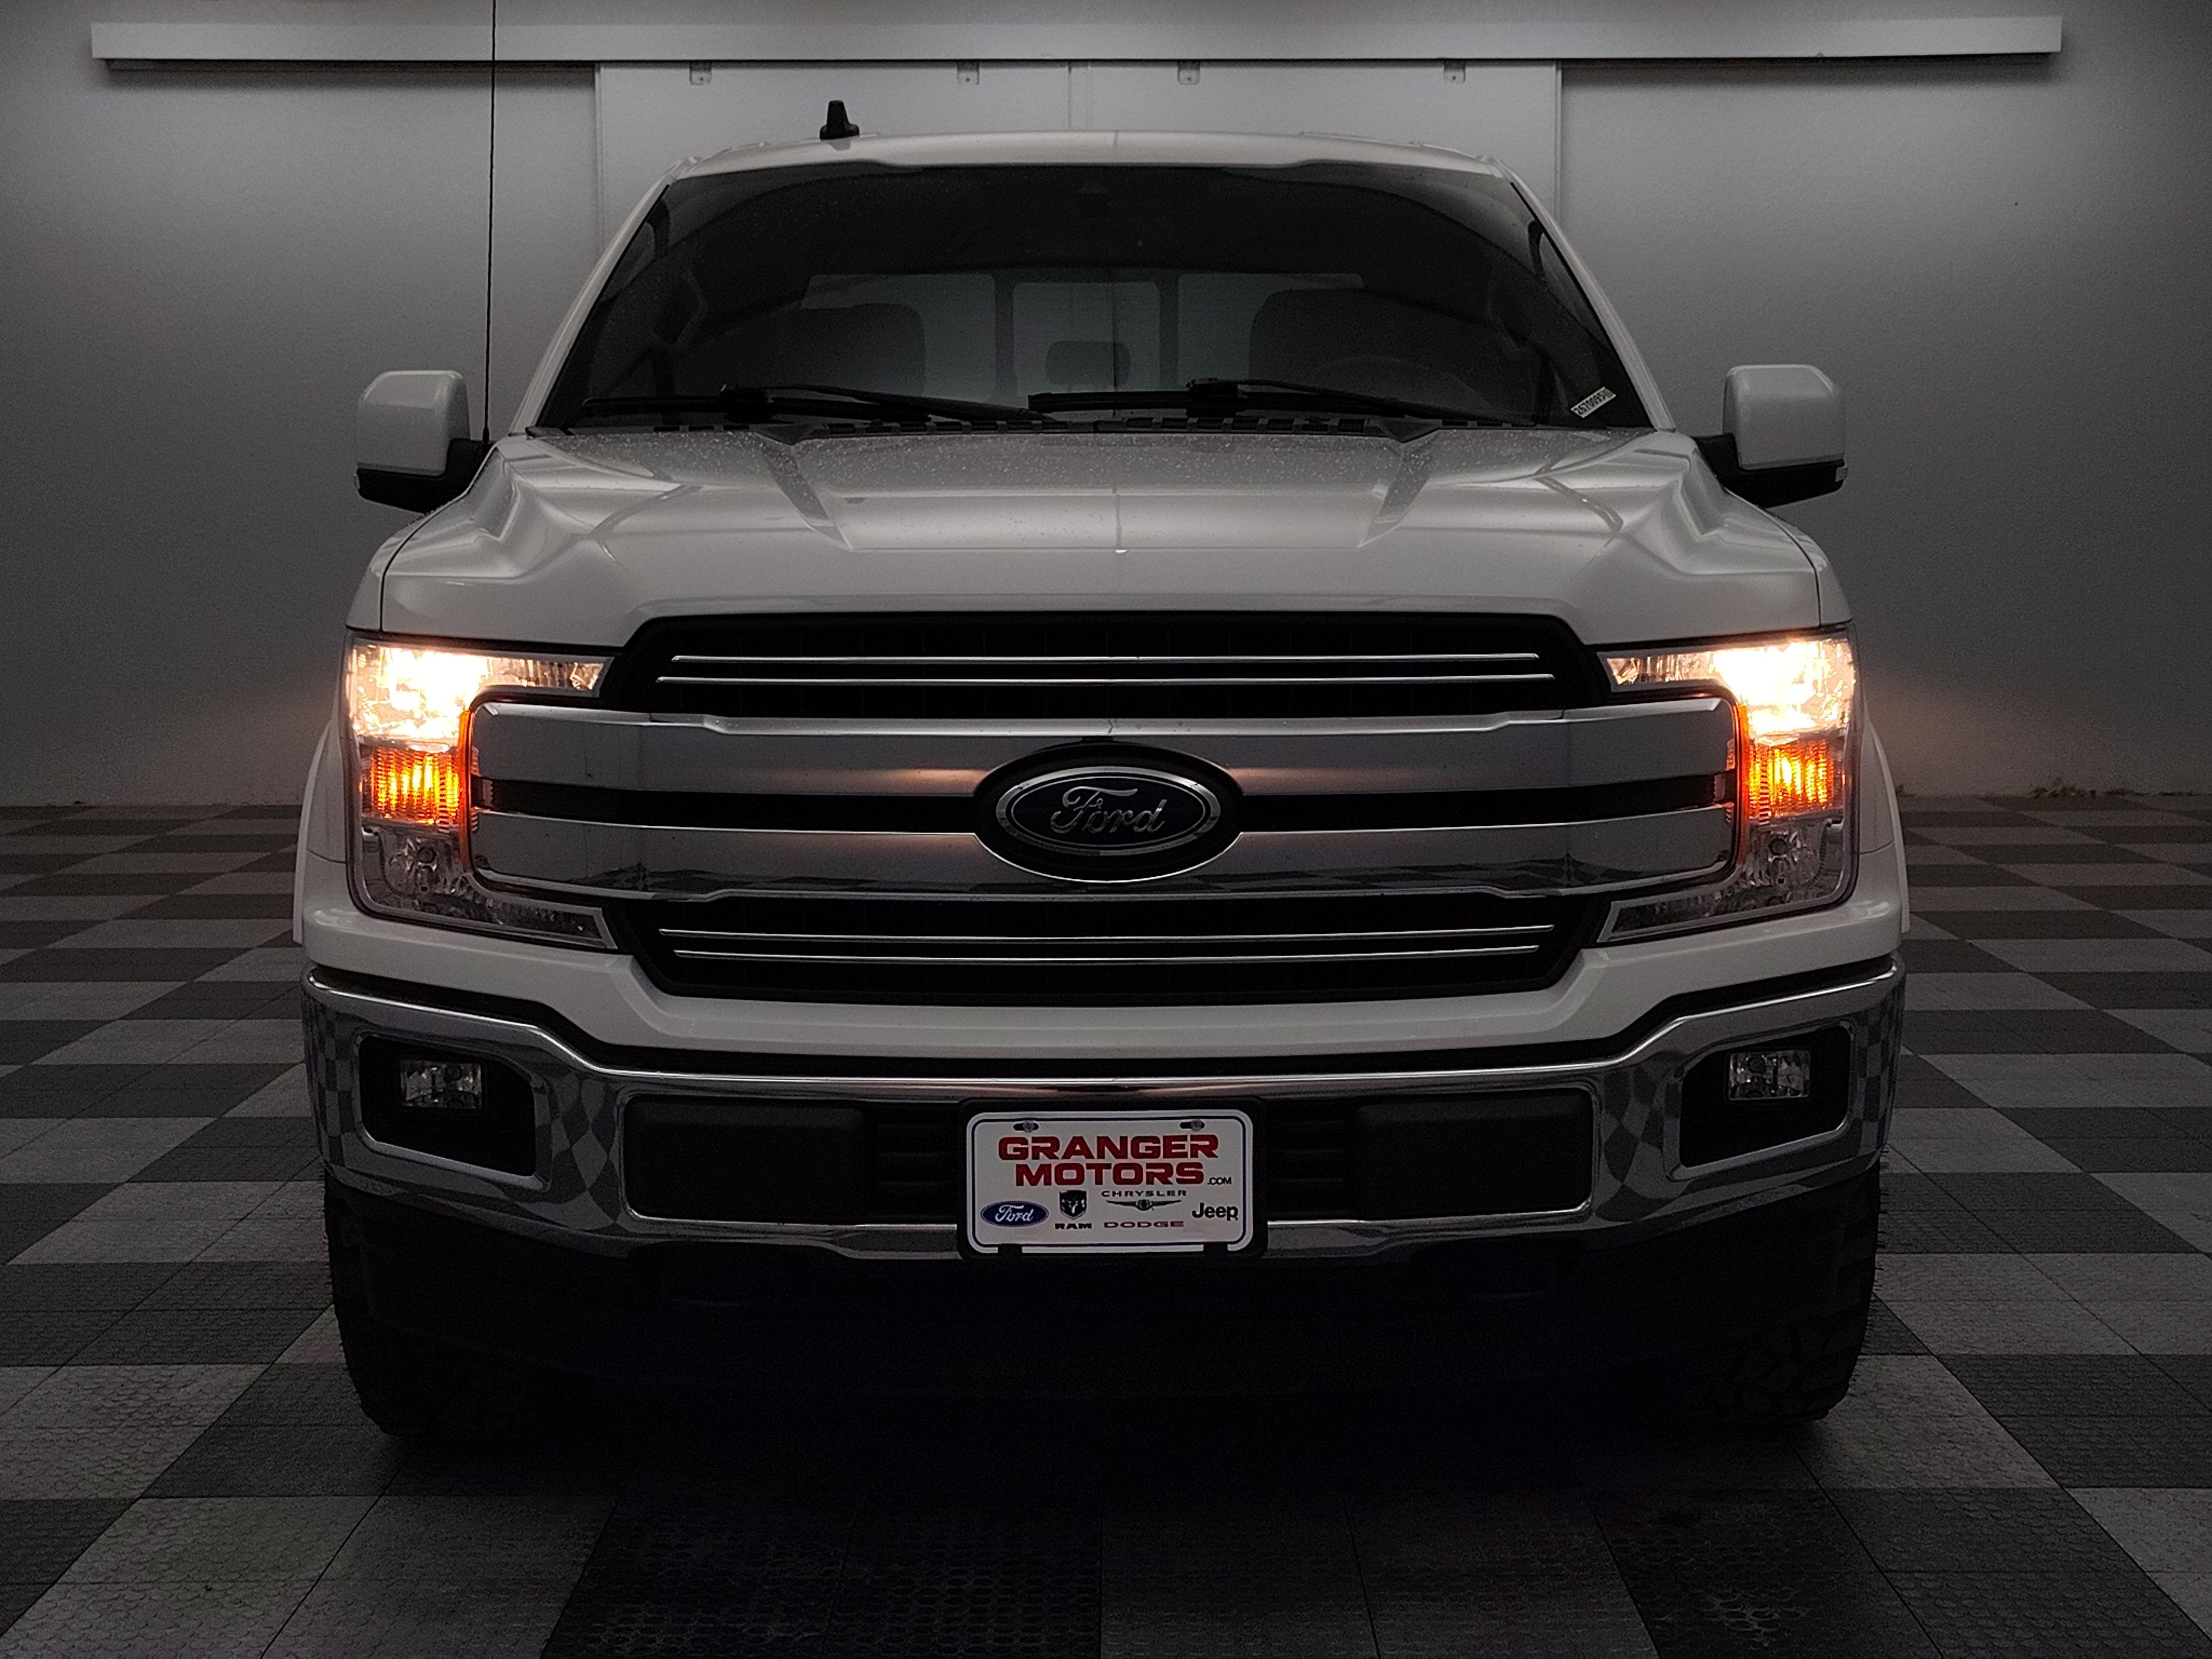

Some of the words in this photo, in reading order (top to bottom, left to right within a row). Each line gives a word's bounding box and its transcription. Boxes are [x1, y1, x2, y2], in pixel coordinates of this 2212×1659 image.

[1050, 786, 1167, 833] Ford
[998, 1135, 1218, 1160] GRANGER
[1015, 1162, 1204, 1186] MOTORS
[1207, 1176, 1231, 1185] .COM
[995, 1204, 1034, 1223] Ford
[1192, 1203, 1238, 1221] Jeep
